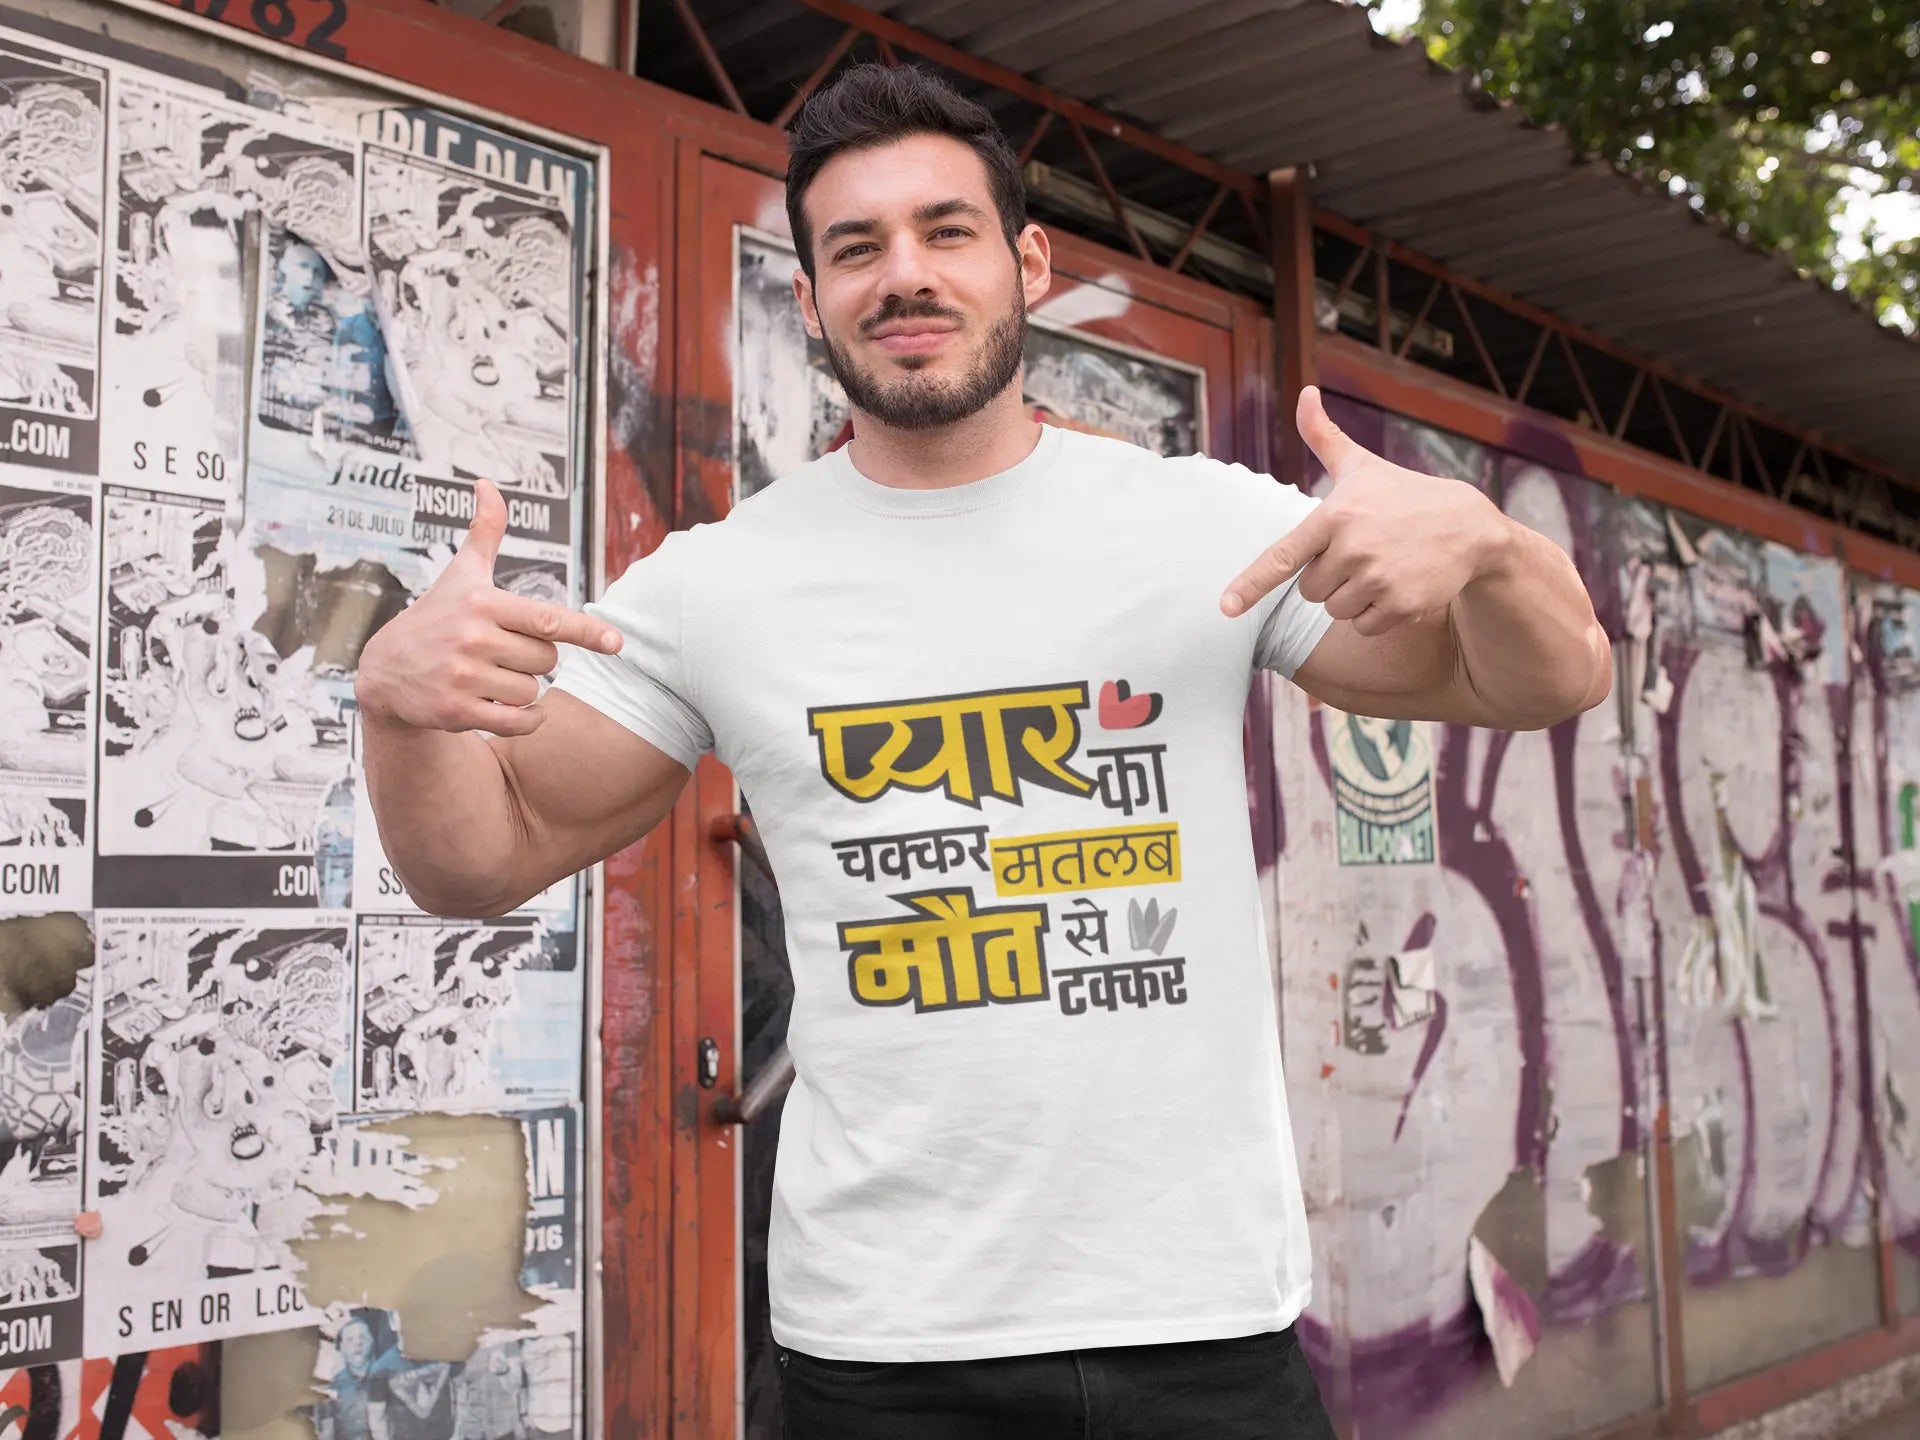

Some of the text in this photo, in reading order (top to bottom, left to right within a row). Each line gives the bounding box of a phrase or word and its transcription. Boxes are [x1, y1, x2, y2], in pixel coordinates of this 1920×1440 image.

[0, 419, 71, 459] .COM
[133, 441, 147, 470] S
[165, 446, 177, 474] E
[347, 509, 364, 530] DE
[366, 514, 404, 537] JULIO
[806, 680, 1168, 816] प्यार का
[831, 825, 1177, 888] चक्कर मतलब
[836, 886, 1109, 1014] मौत से
[1052, 957, 1188, 1016] टक्कर
[118, 1306, 134, 1337] S
[151, 1298, 183, 1333] EN
[200, 1293, 231, 1325] OR
